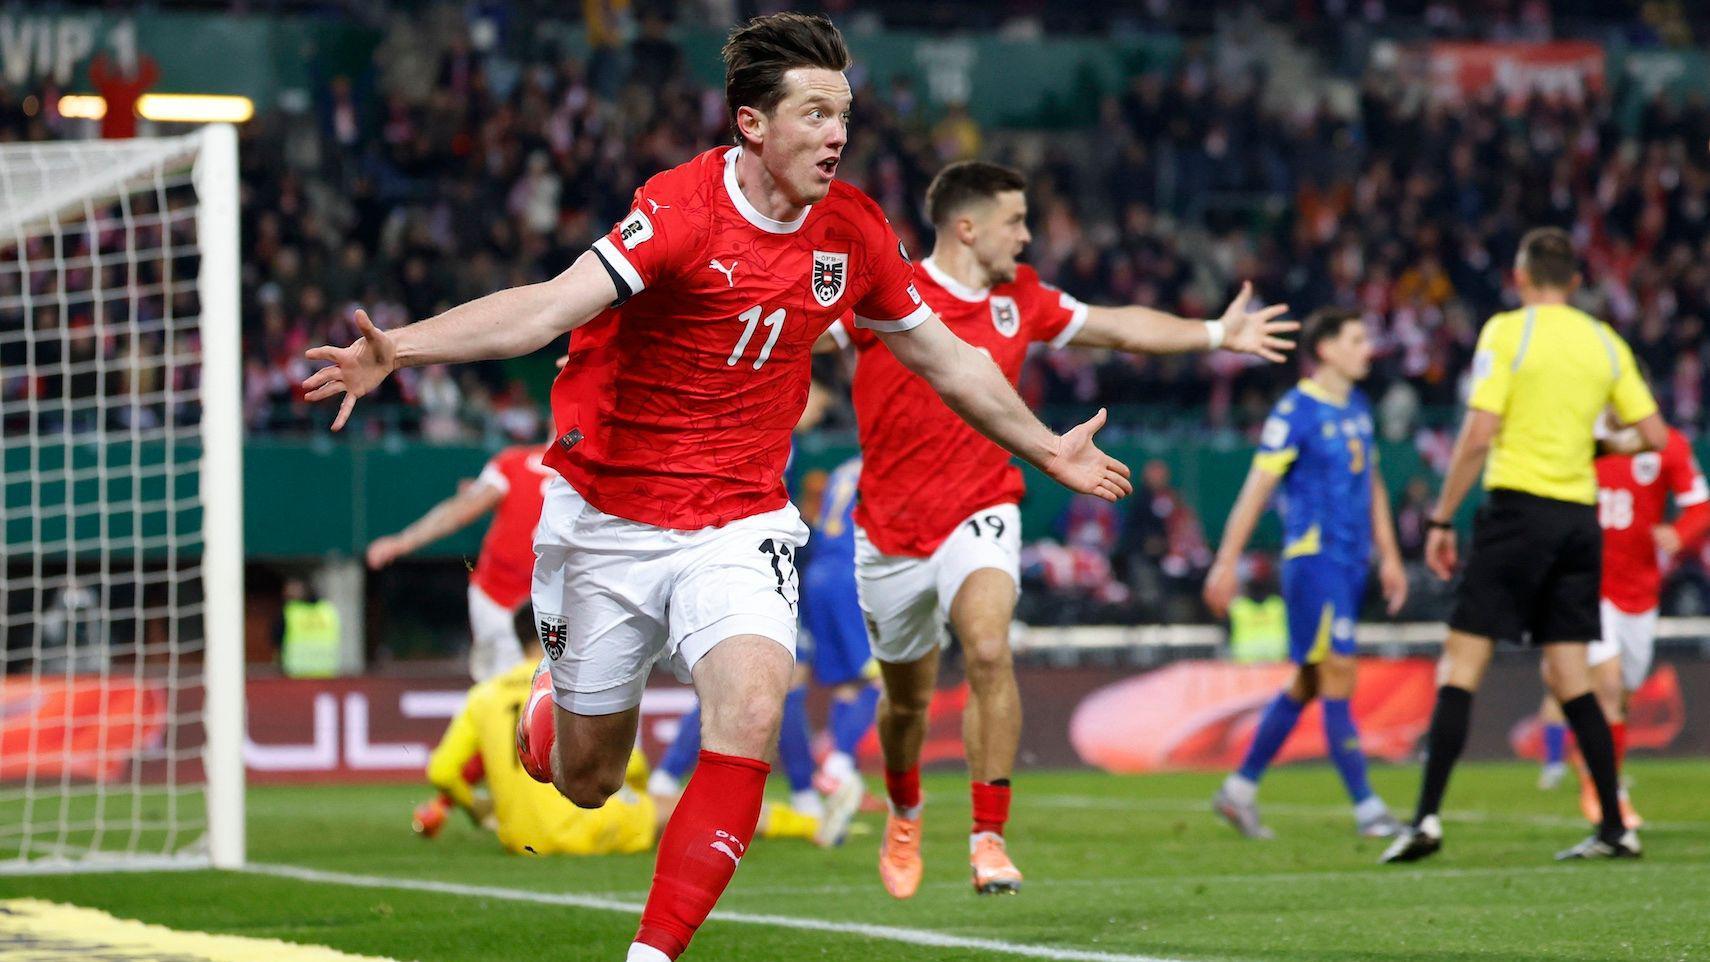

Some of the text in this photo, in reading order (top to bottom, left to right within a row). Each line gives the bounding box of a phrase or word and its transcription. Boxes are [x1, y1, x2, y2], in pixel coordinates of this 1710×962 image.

[0, 14, 138, 86] VIP 1
[727, 304, 787, 370] 11
[966, 514, 1005, 539] 19
